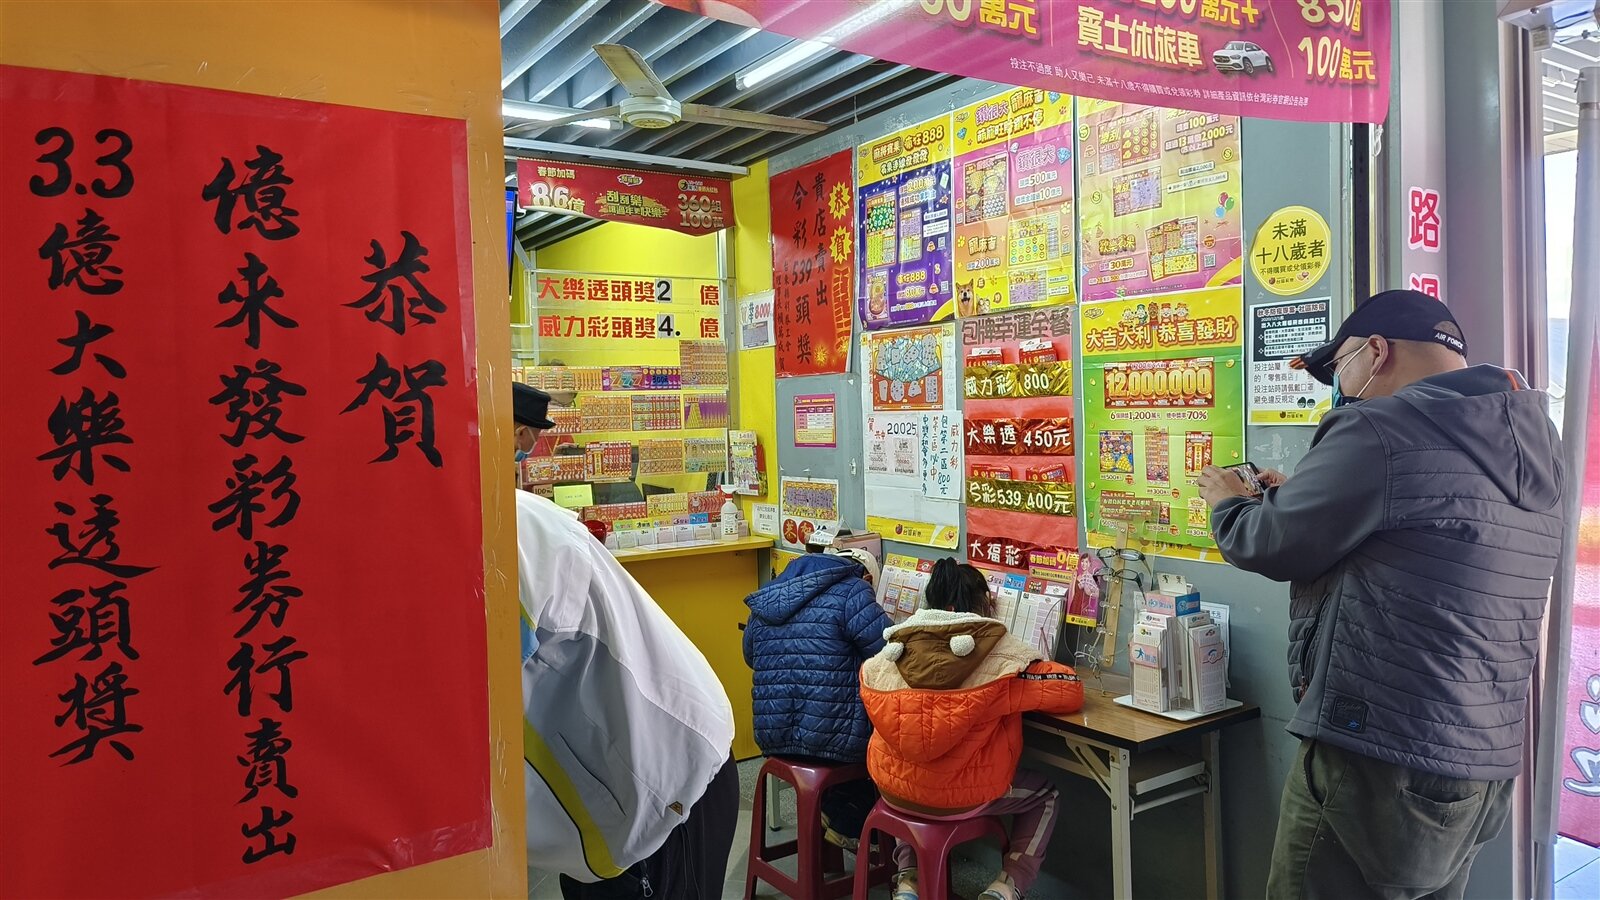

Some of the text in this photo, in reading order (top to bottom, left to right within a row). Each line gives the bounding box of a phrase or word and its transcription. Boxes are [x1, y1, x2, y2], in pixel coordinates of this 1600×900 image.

[1077, 5, 1203, 67] 賓士休旅車
[1297, 36, 1376, 80] 100萬元
[1054, 66, 1096, 84] 助人又樂己
[537, 166, 576, 179] 春節加碼
[831, 186, 848, 260] 恭賀
[1272, 218, 1307, 241] 未滿
[811, 172, 829, 307] 貴店賣出
[1255, 239, 1326, 265] 十八歲者
[792, 180, 814, 365] 今彩539頭獎
[1259, 261, 1322, 276] 不得購買或兌領彩券
[699, 284, 721, 306] 億
[699, 317, 721, 339] 億
[962, 308, 1071, 346] 包牌幸運全餐
[1087, 317, 1237, 349] 大吉大利 恭喜發財
[339, 230, 449, 469] 恭賀
[1435, 332, 1464, 350] AIR FORCE
[965, 371, 1049, 396] 威力彩 800
[887, 421, 918, 436] 20025
[967, 424, 1071, 448] 大樂透 450元
[949, 423, 960, 470] 威力彩
[201, 144, 309, 866] 億來發彩券行賣出
[1027, 491, 1071, 514] 400元
[970, 539, 1021, 566] 大福彩
